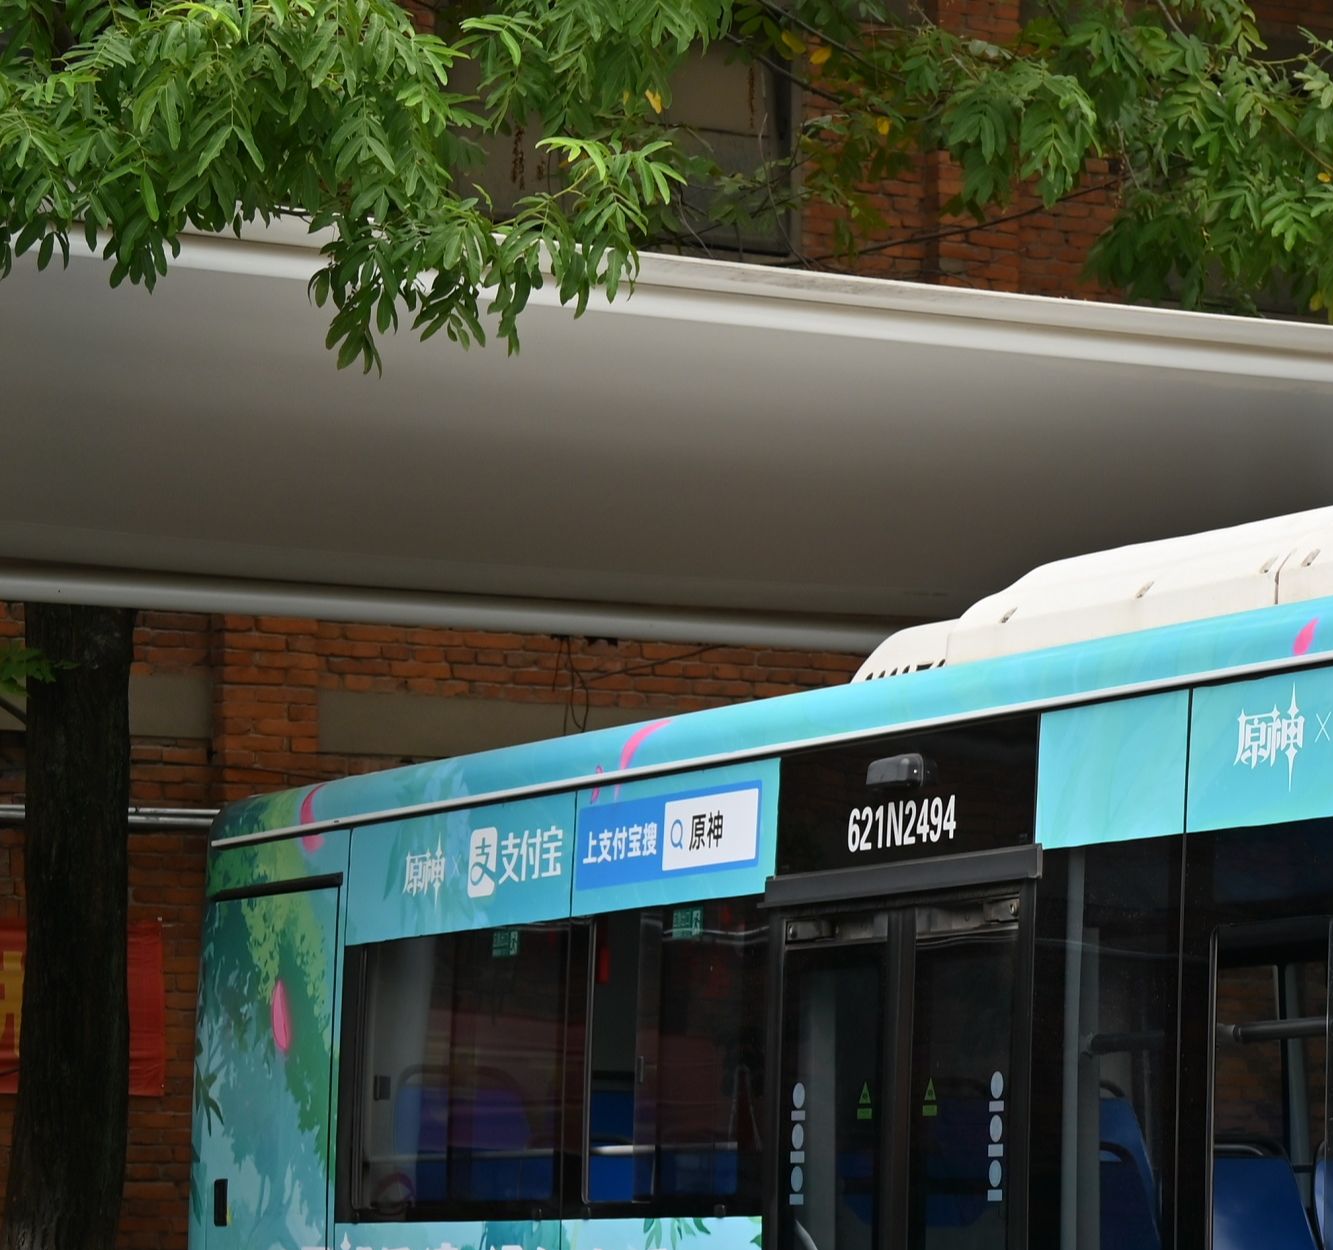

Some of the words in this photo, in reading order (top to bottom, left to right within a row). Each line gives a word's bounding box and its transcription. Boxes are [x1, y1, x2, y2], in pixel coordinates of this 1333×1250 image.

[1233, 682, 1305, 792] 原神
[582, 823, 658, 865] 上支付宝搜
[688, 810, 724, 852] 原神
[847, 794, 957, 853] 621N2494
[498, 825, 564, 885] 支付宝
